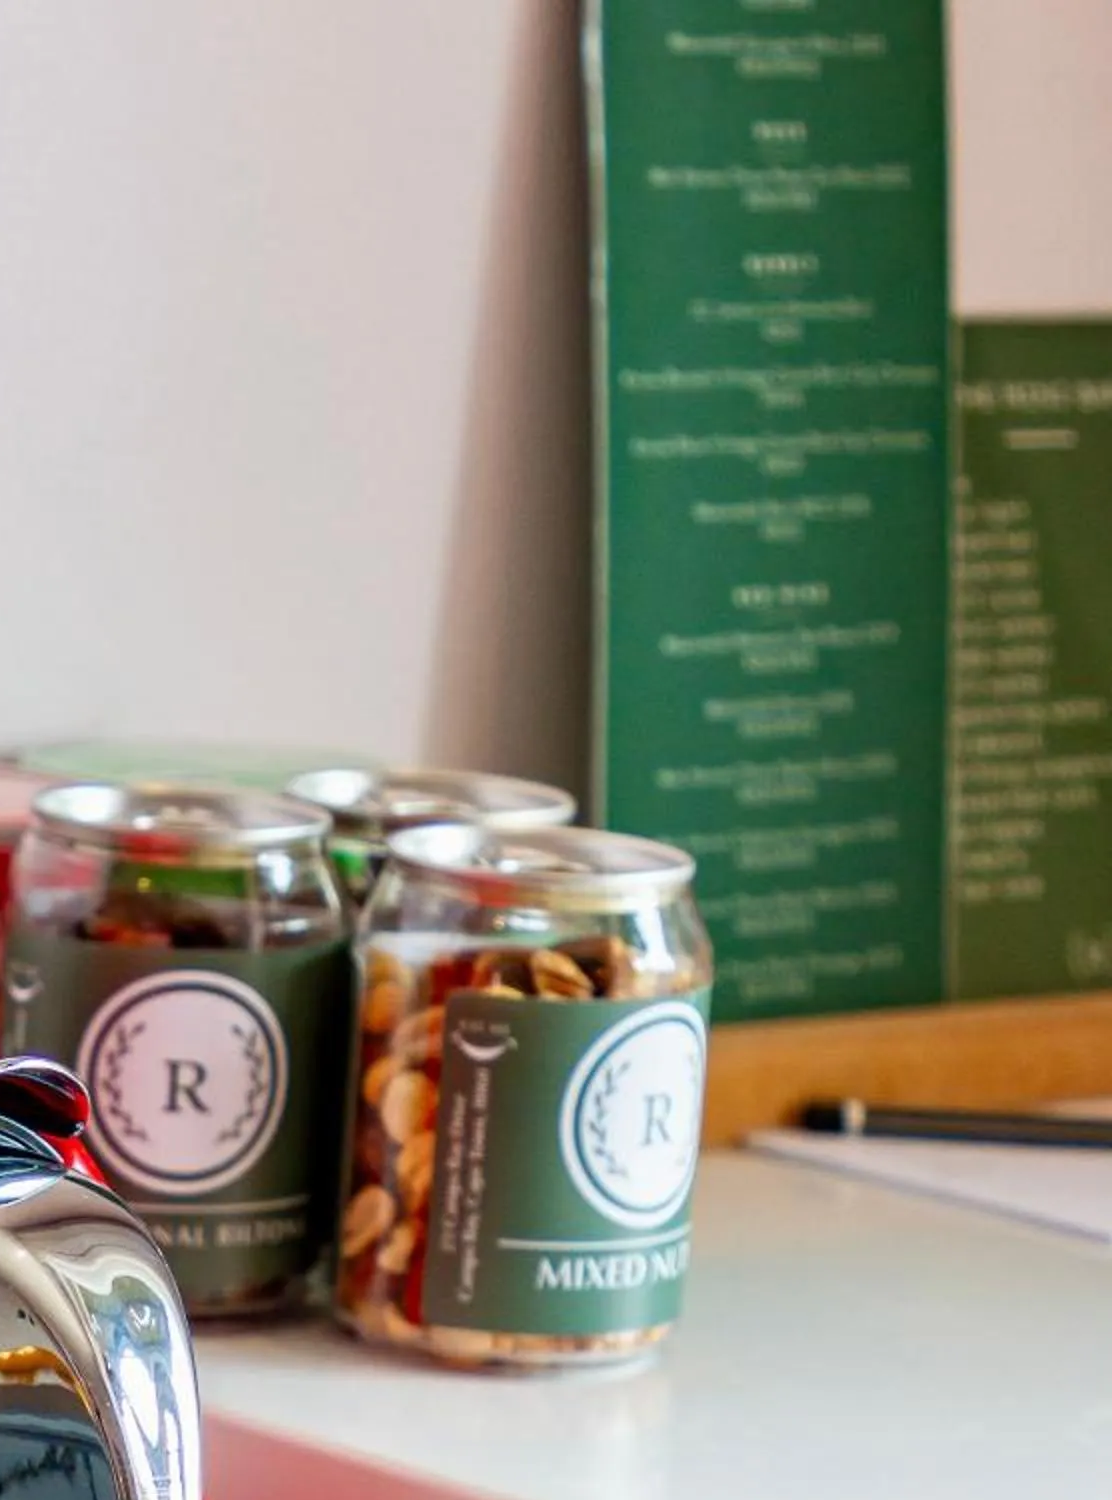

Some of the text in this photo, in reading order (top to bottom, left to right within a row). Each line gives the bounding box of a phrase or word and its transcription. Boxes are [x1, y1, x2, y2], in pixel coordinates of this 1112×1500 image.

[162, 1059, 211, 1114] R
[643, 1094, 673, 1147] R
[465, 1166, 485, 1208] Cape
[456, 1245, 480, 1303] Camps
[536, 1253, 647, 1290] MIXED
